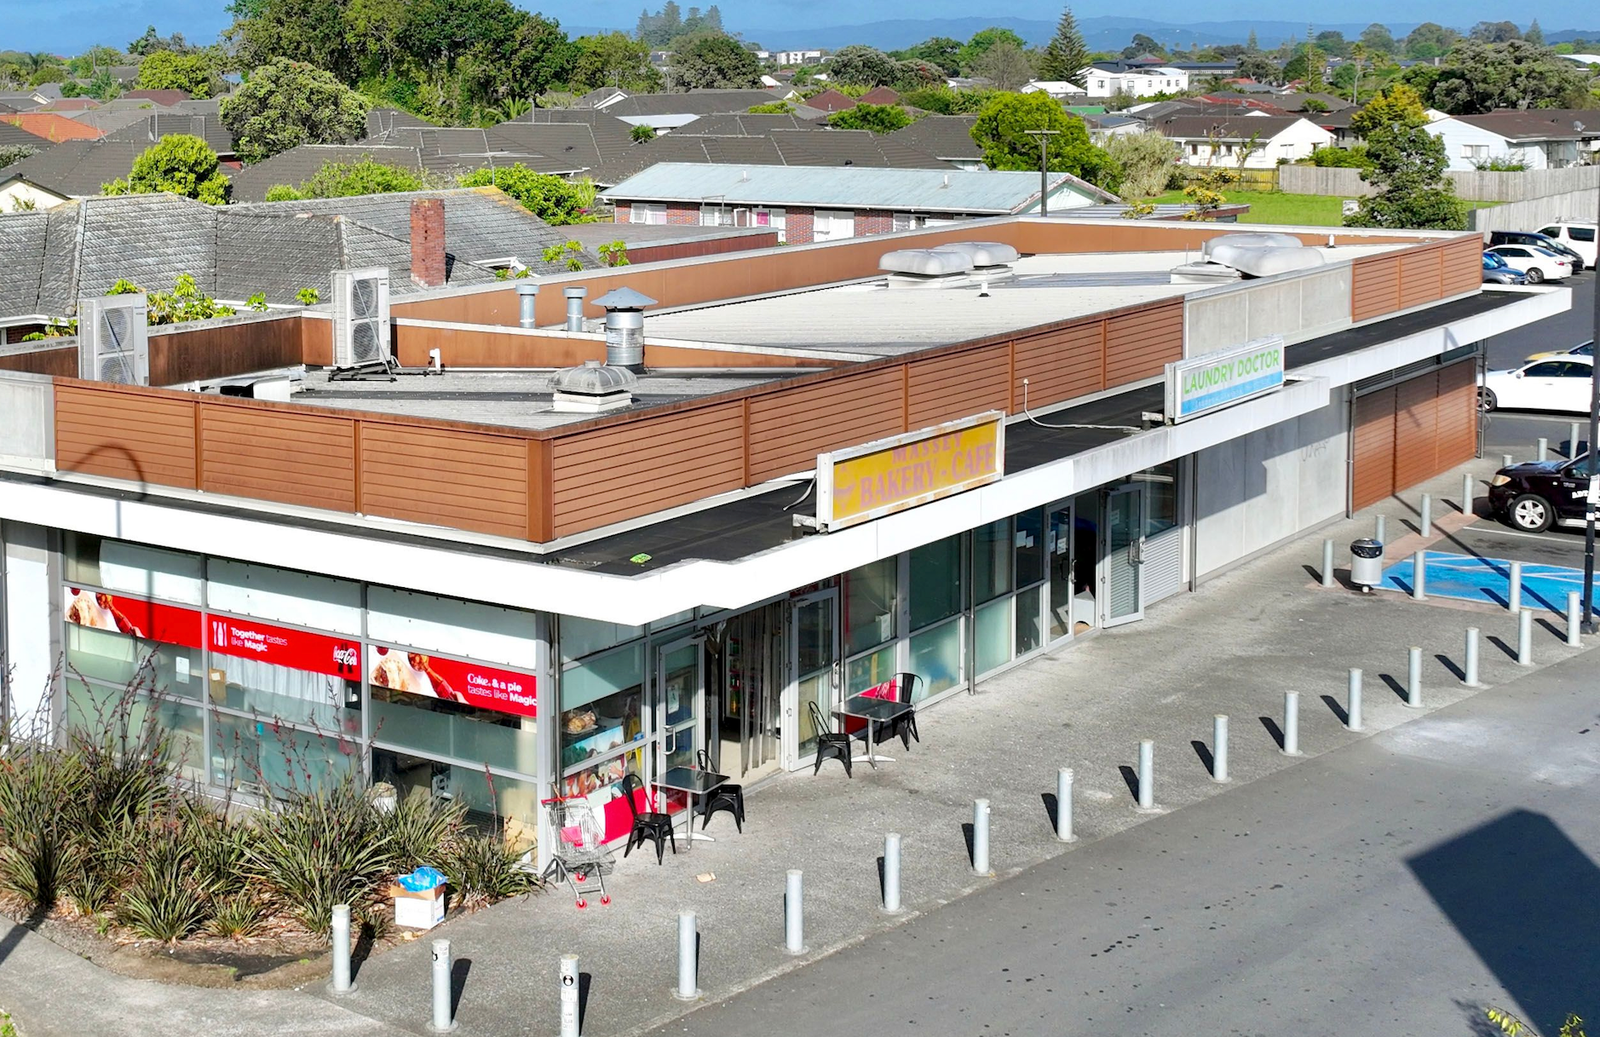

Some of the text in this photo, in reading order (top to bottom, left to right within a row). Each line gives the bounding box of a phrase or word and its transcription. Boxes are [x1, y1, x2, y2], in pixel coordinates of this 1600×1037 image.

[1183, 362, 1236, 395] LAUNDRY
[1237, 349, 1280, 378] DOCTOR
[892, 432, 963, 465] MASSEY
[859, 458, 938, 510] BAKERY
[951, 442, 995, 481] CAFE
[230, 627, 288, 647] Together tastes
[230, 637, 268, 652] like Magic
[467, 685, 538, 707] tastes like Magic
[491, 678, 499, 689] &
[500, 681, 507, 690] a
[507, 682, 523, 693] pie
